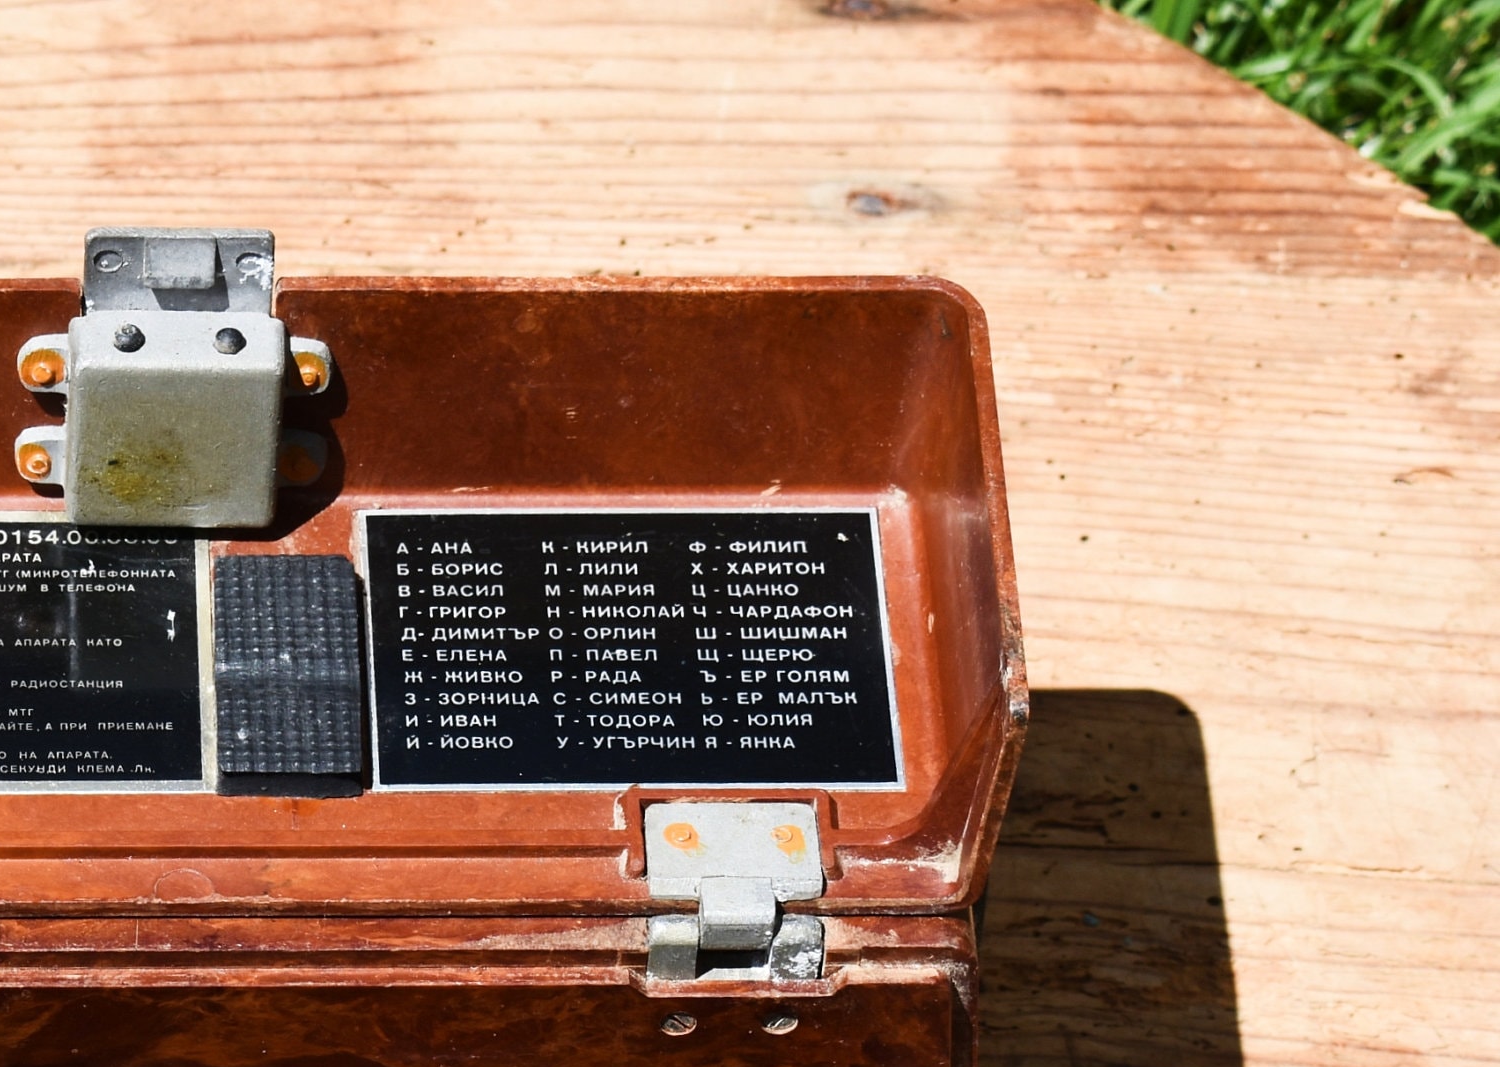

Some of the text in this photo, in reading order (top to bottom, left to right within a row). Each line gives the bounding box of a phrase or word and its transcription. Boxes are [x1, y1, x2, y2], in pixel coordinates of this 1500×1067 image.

[396, 541, 473, 555] А АНА
[541, 540, 649, 554] К КИРИЛ
[688, 540, 808, 554] Ф ФИЛИП
[396, 562, 504, 577] Б БОРИС
[543, 562, 639, 576] Л ЛИЛИ
[690, 561, 826, 576] Х ХАРИТОН
[57, 582, 136, 593] ТЕЛЕФОНА
[397, 584, 504, 598] В ВАСИЛ
[544, 583, 656, 597] М МАРИЯ
[691, 583, 800, 599] Ц ЦАНКО
[398, 605, 507, 620] Г ГРИГОР
[546, 603, 685, 619] Н НИКОЛАЙ
[692, 604, 854, 621] Ч ЧАРДАФОН
[430, 627, 540, 643] ДИМИТЪР
[548, 626, 657, 640] О ОРЛИН
[695, 626, 848, 642] Ш ШИШМАН
[14, 637, 77, 647] АПАРАТА
[86, 637, 123, 647] КАТО
[401, 648, 508, 662] Е ЕЛЕНА
[549, 648, 658, 662] П ПАВЕЛ
[696, 648, 814, 664] Щ ЩЕРЮ
[404, 670, 524, 684] Ж ЖИВКО
[550, 670, 642, 685] Р РАДА
[699, 669, 850, 684] Ъ ЕР ГОЛЯМ
[10, 680, 124, 691] РАДИОСТАНЦИЯ
[404, 691, 540, 707] З ЗОРНИЦА
[552, 691, 682, 706] С СИМЕОН
[700, 691, 858, 706] Ь ЕР МАЛЪК
[8, 708, 35, 718] МТГ
[702, 713, 813, 727] Ю ЮЛИЯ
[59, 722, 88, 732] ПРИ
[97, 722, 174, 732] ПРИЕМАНЕ
[405, 714, 497, 728] И ИВАН
[553, 714, 676, 730] Т ТОДОРА
[405, 733, 514, 750] Й ЙОВКО
[556, 735, 696, 750] У УГЪРЧИН
[704, 735, 796, 749] Я ЯНКА
[0, 764, 67, 775] СЕКУНДИ
[76, 764, 125, 774] КЛЕМА
